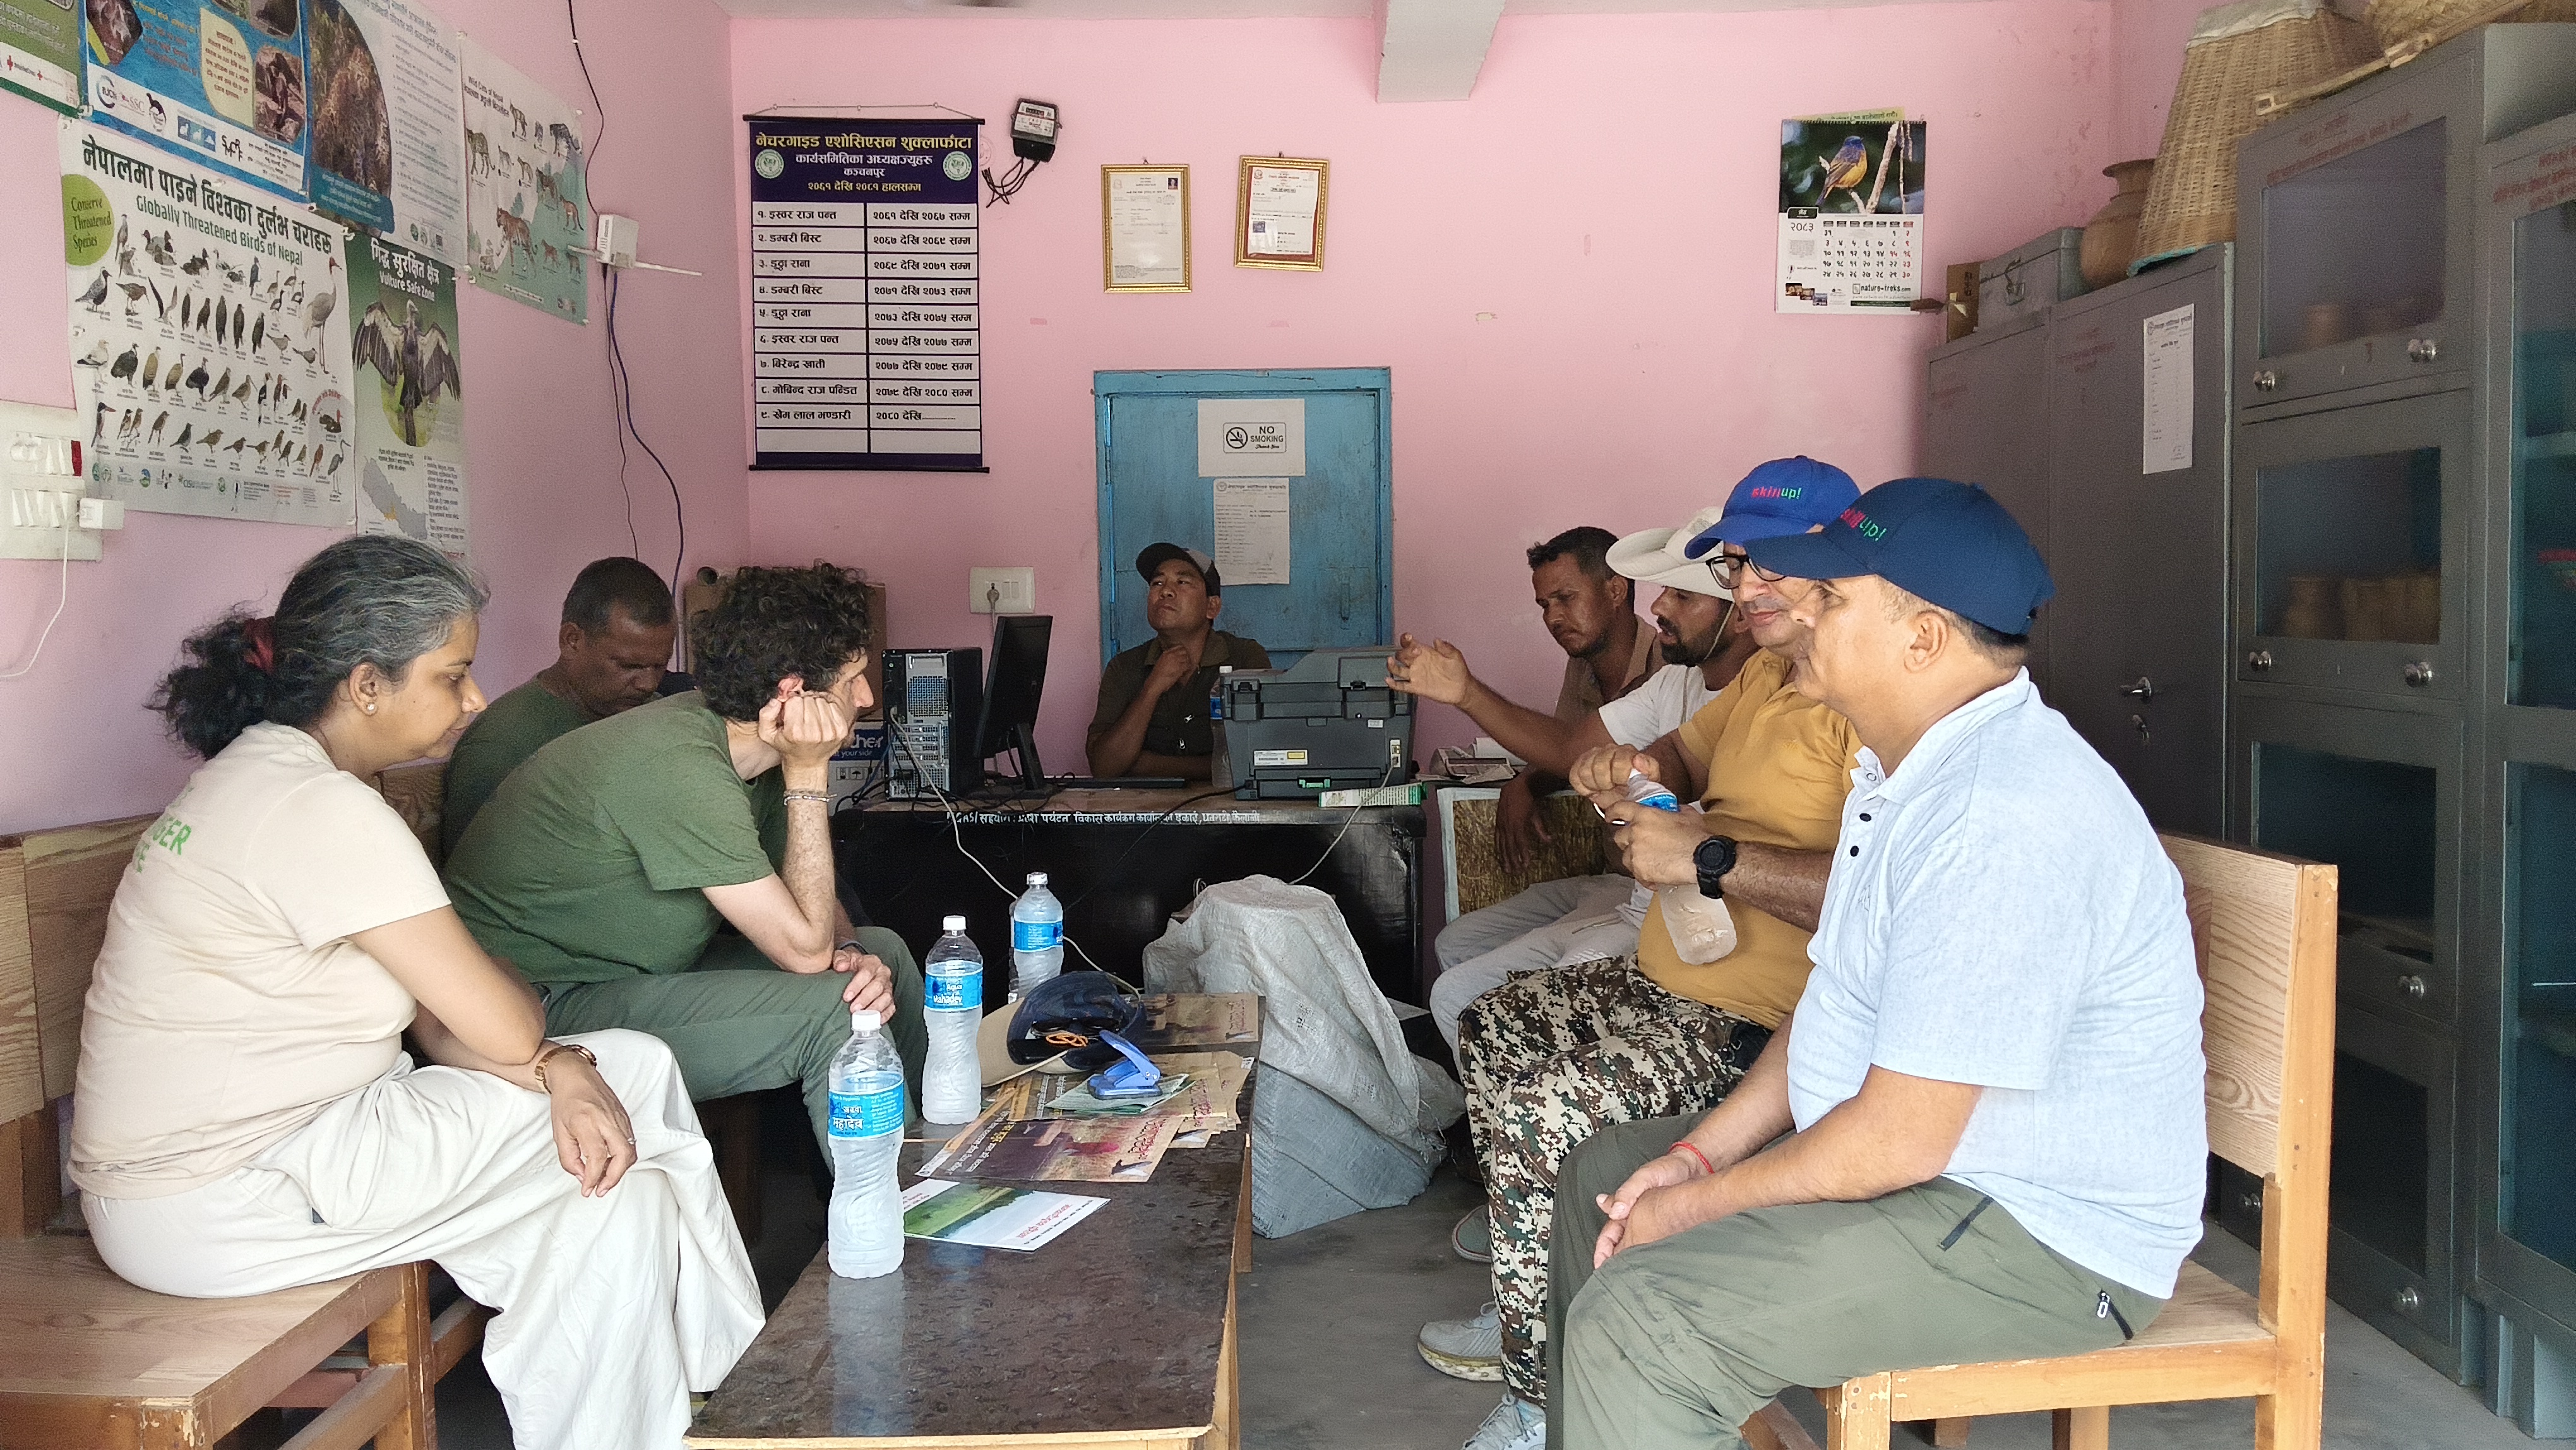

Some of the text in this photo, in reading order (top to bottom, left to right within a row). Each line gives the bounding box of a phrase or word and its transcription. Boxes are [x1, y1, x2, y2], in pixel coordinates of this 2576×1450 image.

[755, 132, 821, 150] नेचरगाइड
[796, 152, 863, 164] कार्यसमितिका
[83, 135, 153, 190] नेपालमा
[158, 174, 198, 207] पाइने
[201, 179, 253, 226] विश्वका
[256, 206, 289, 239] दुर्लभ
[808, 183, 832, 191] २०६१
[834, 181, 853, 191] देखि
[881, 183, 921, 192] हालसम्म
[796, 210, 814, 219] राज
[817, 211, 837, 220] पन्त
[873, 210, 970, 221] २०६१ देखि २०६७ सम्म
[73, 212, 112, 231] Threatened
[136, 195, 303, 266] Globally Threatened Birds of Nepal
[769, 232, 797, 243] डम्बरी
[873, 234, 970, 246] २०६७ देखि २०६९ सम्म
[73, 234, 98, 253] Species
[371, 237, 390, 269] गिद्ध
[391, 251, 425, 279] सुरक्षित
[759, 260, 768, 268] ३.
[790, 259, 810, 268] राना
[874, 260, 970, 271] २०६९ देखि २०७१ सम्म
[379, 270, 435, 302] Vulture Safe Zone
[771, 284, 799, 295] डम्बरी
[900, 285, 920, 296] देखि
[922, 287, 946, 296] २०७३
[950, 287, 972, 296] सम्म
[759, 309, 768, 318] ५.
[791, 309, 811, 318] राना
[874, 311, 972, 323] २०७३ देखि २०७५ सम्म
[760, 335, 769, 344] ६.
[799, 335, 817, 344] राज
[874, 336, 972, 347] २०७५ देखि २०७७ सम्म
[902, 360, 922, 371] देखि
[924, 362, 948, 371] २०७९
[951, 362, 973, 371] सम्म
[807, 386, 825, 395] राज
[902, 386, 922, 397] देखि
[951, 389, 973, 397] सम्म
[772, 409, 790, 419] खेम
[793, 411, 815, 420] लाल
[818, 410, 851, 420] भण्डारी
[1073, 812, 1103, 824] विकास
[832, 1115, 864, 1130] महादेव
